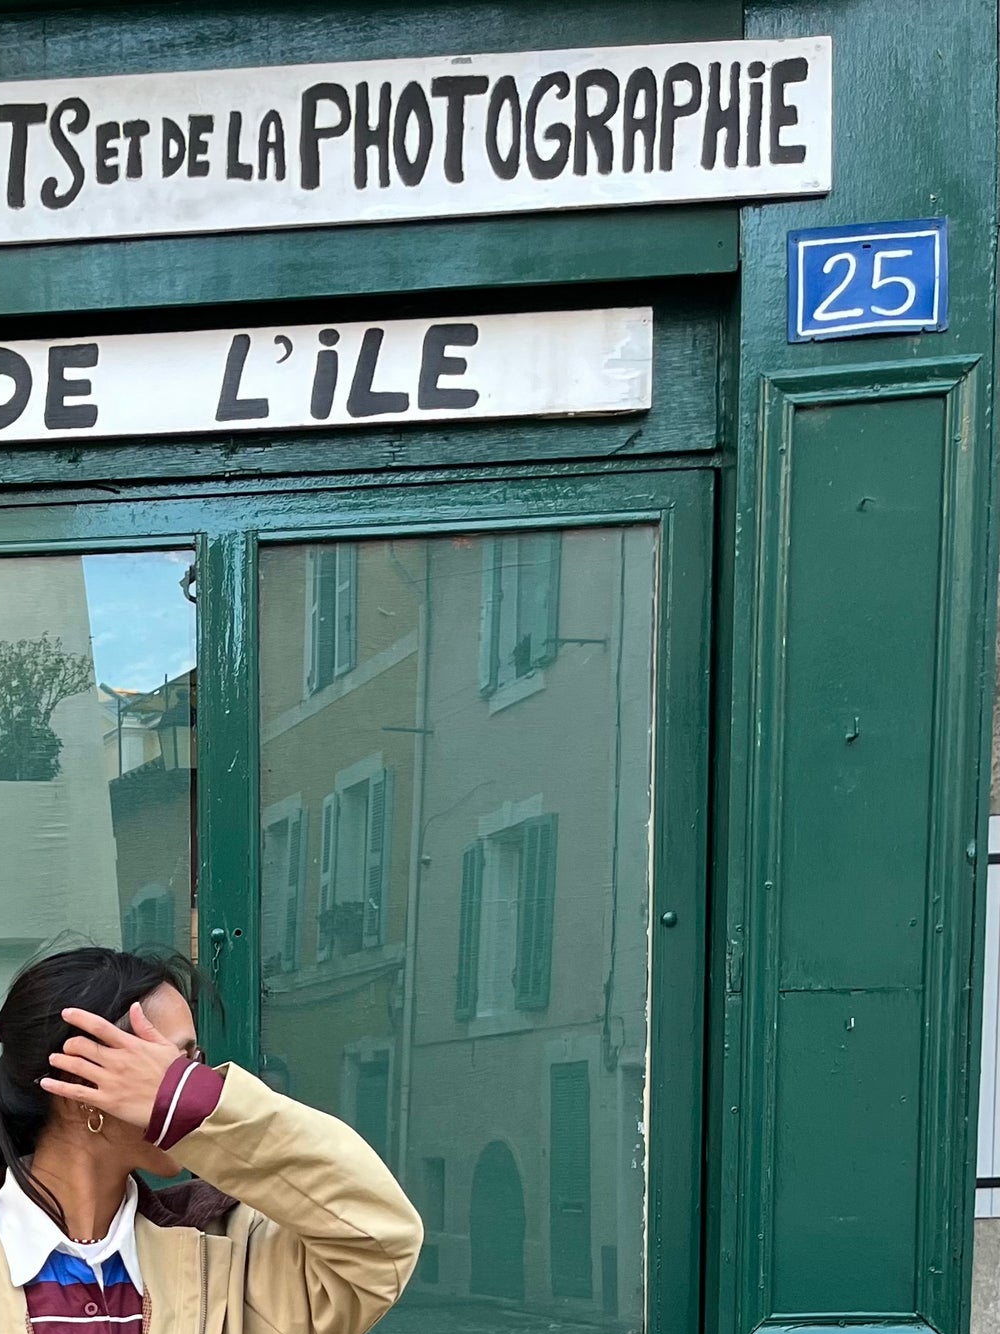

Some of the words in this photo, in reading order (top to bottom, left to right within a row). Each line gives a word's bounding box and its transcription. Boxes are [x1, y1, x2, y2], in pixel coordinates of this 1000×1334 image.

[96, 119, 151, 185] ET
[162, 115, 215, 178] DE
[226, 110, 287, 182] LA
[813, 249, 917, 322] 25
